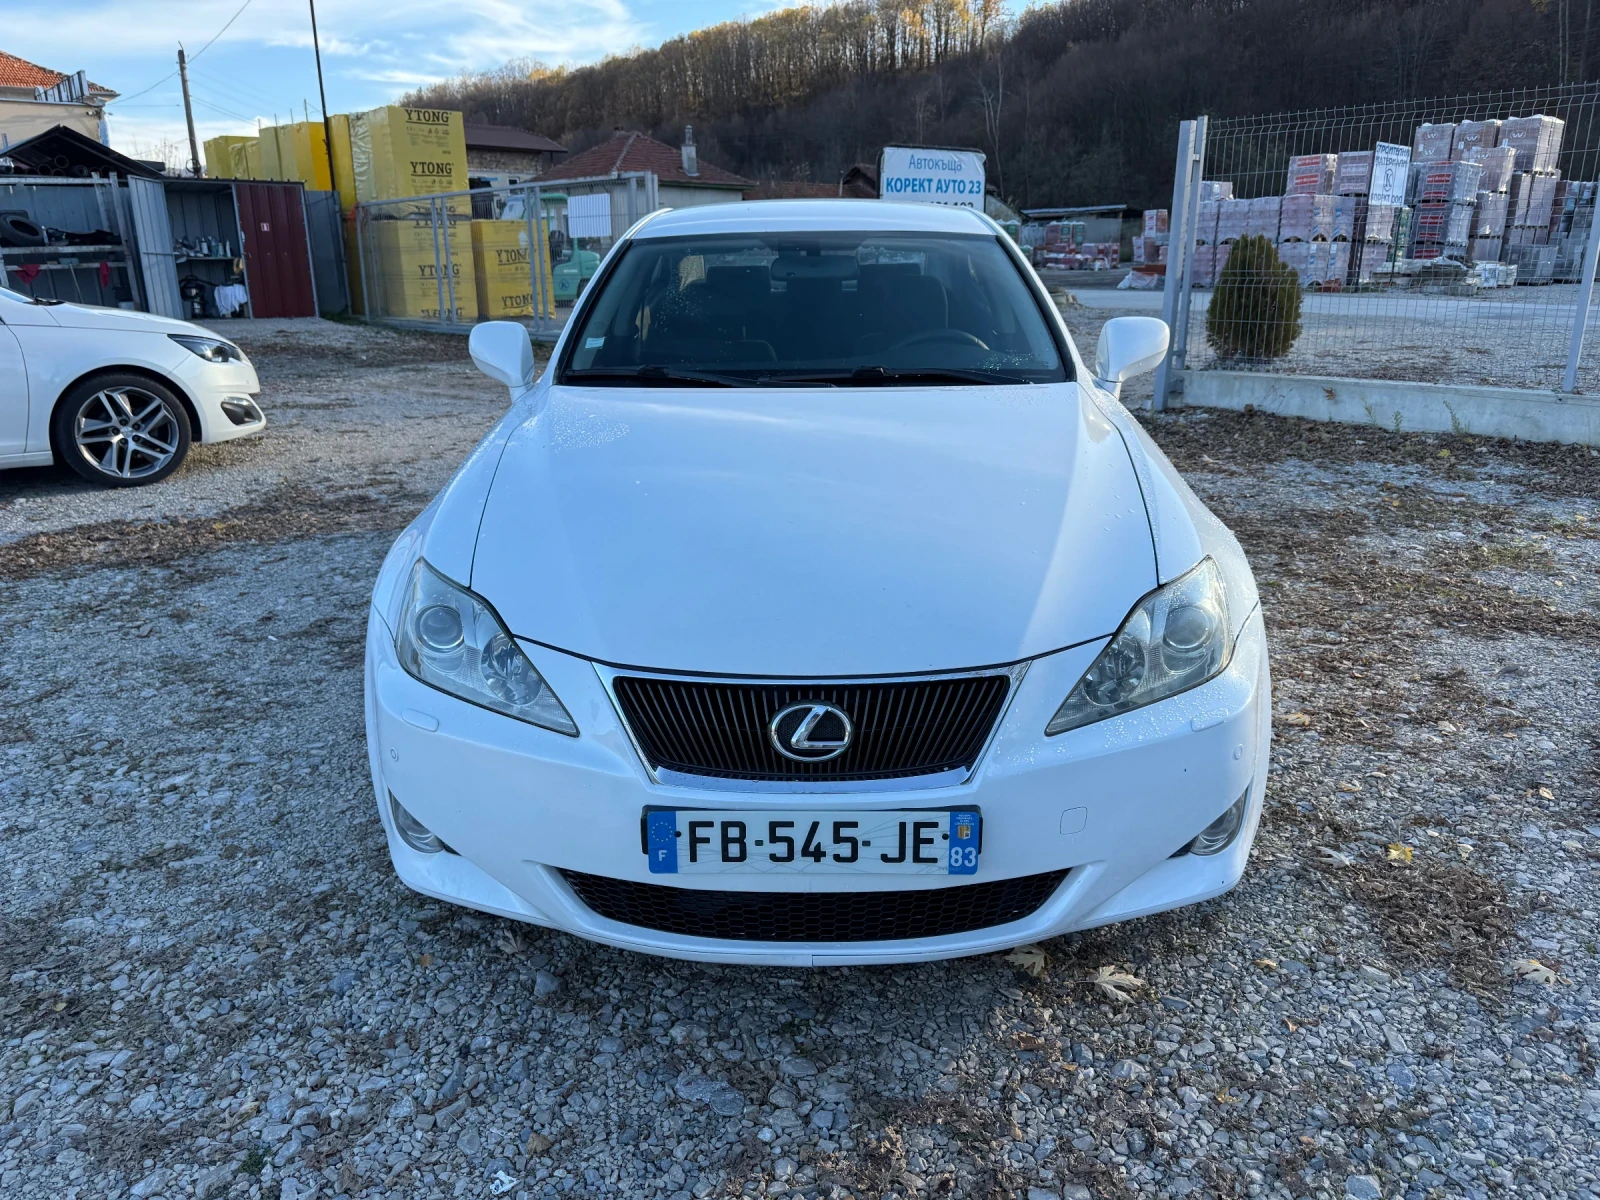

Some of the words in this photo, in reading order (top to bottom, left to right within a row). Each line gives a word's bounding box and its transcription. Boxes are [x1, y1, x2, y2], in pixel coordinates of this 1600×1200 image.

[404, 109, 450, 123] YTONG
[410, 161, 453, 174] YTONG
[886, 178, 933, 193] КОРЕКТ
[935, 179, 966, 194] АУТО
[968, 181, 981, 194] 23
[659, 850, 667, 861] F
[951, 847, 976, 867] 83
